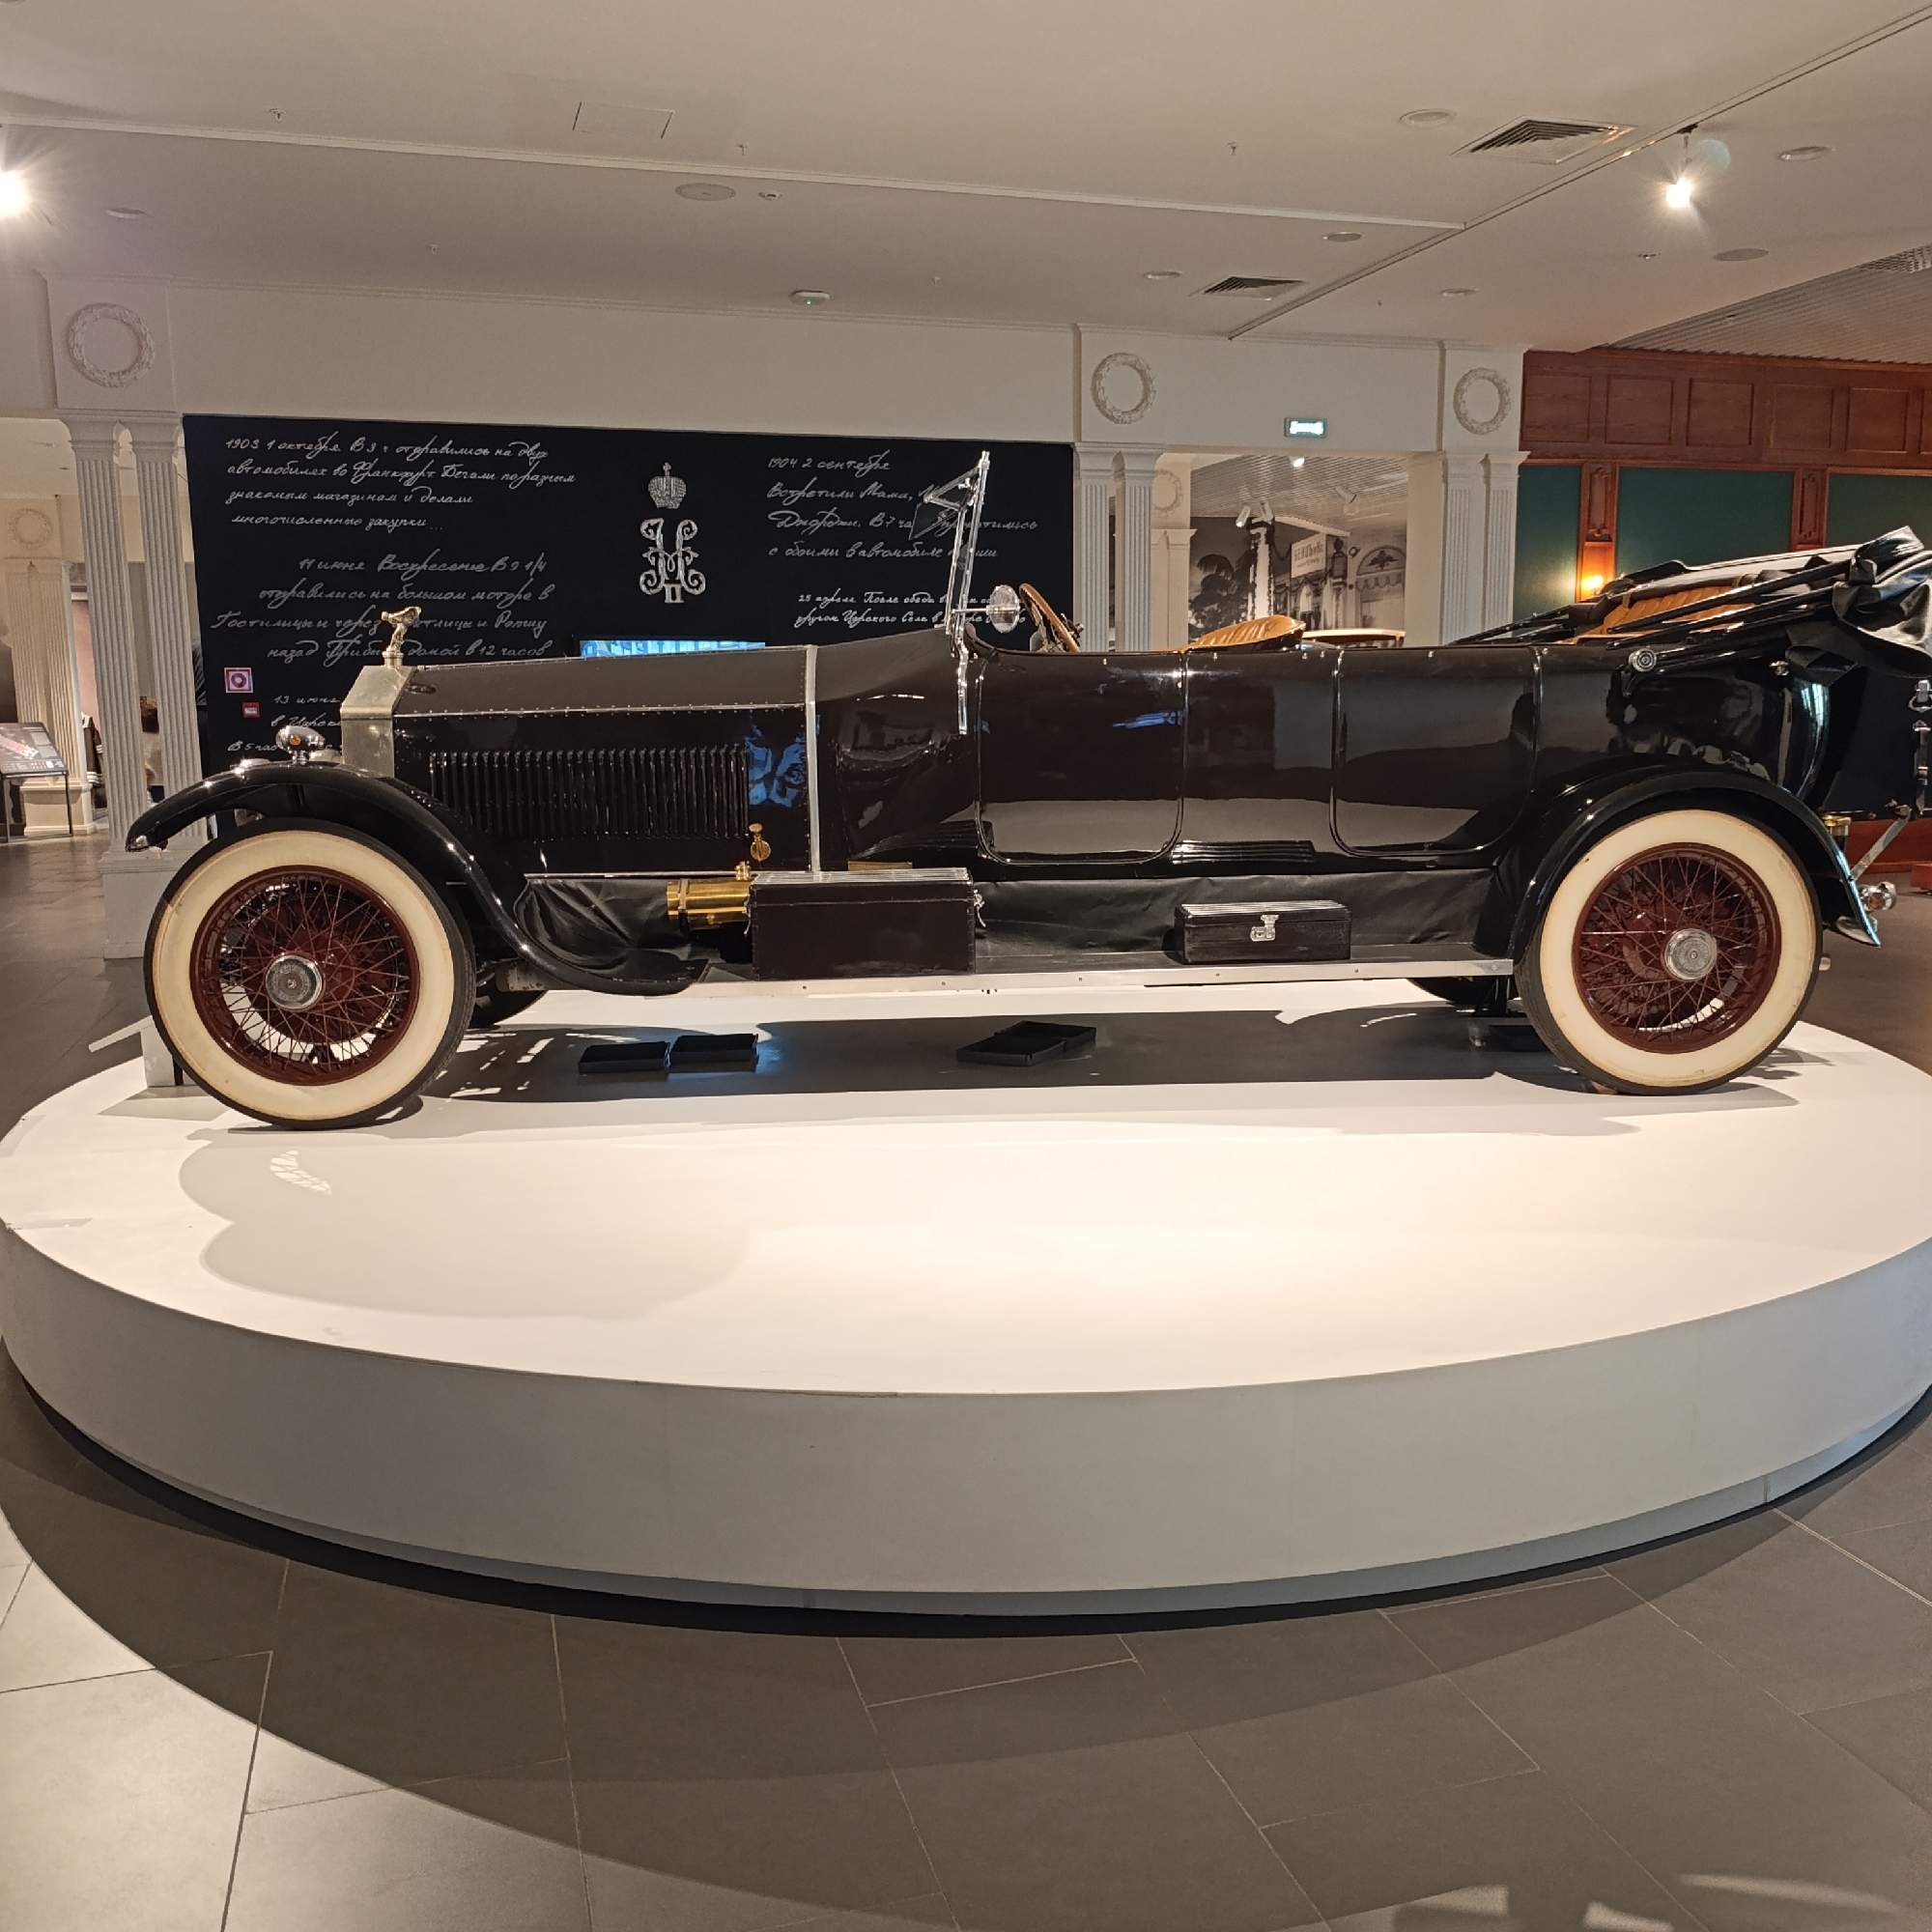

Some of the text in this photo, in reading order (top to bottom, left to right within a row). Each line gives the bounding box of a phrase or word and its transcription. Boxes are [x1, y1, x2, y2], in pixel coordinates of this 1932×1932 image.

[350, 437, 366, 452] В
[395, 435, 490, 462] отправились
[495, 447, 514, 457] на
[227, 458, 327, 475] автомобилях
[332, 464, 348, 476] во
[768, 449, 891, 478] 1904 2 сентября
[412, 486, 474, 503] делали
[767, 476, 855, 505] Встретили
[232, 514, 363, 525] многочисленные
[886, 516, 895, 527] 7
[769, 547, 779, 555] с
[258, 578, 367, 609] отправились
[370, 589, 390, 599] на
[397, 583, 466, 600] большом
[538, 583, 555, 600] в
[335, 605, 383, 638] через
[267, 639, 320, 664] назад
[501, 639, 553, 656] часов
